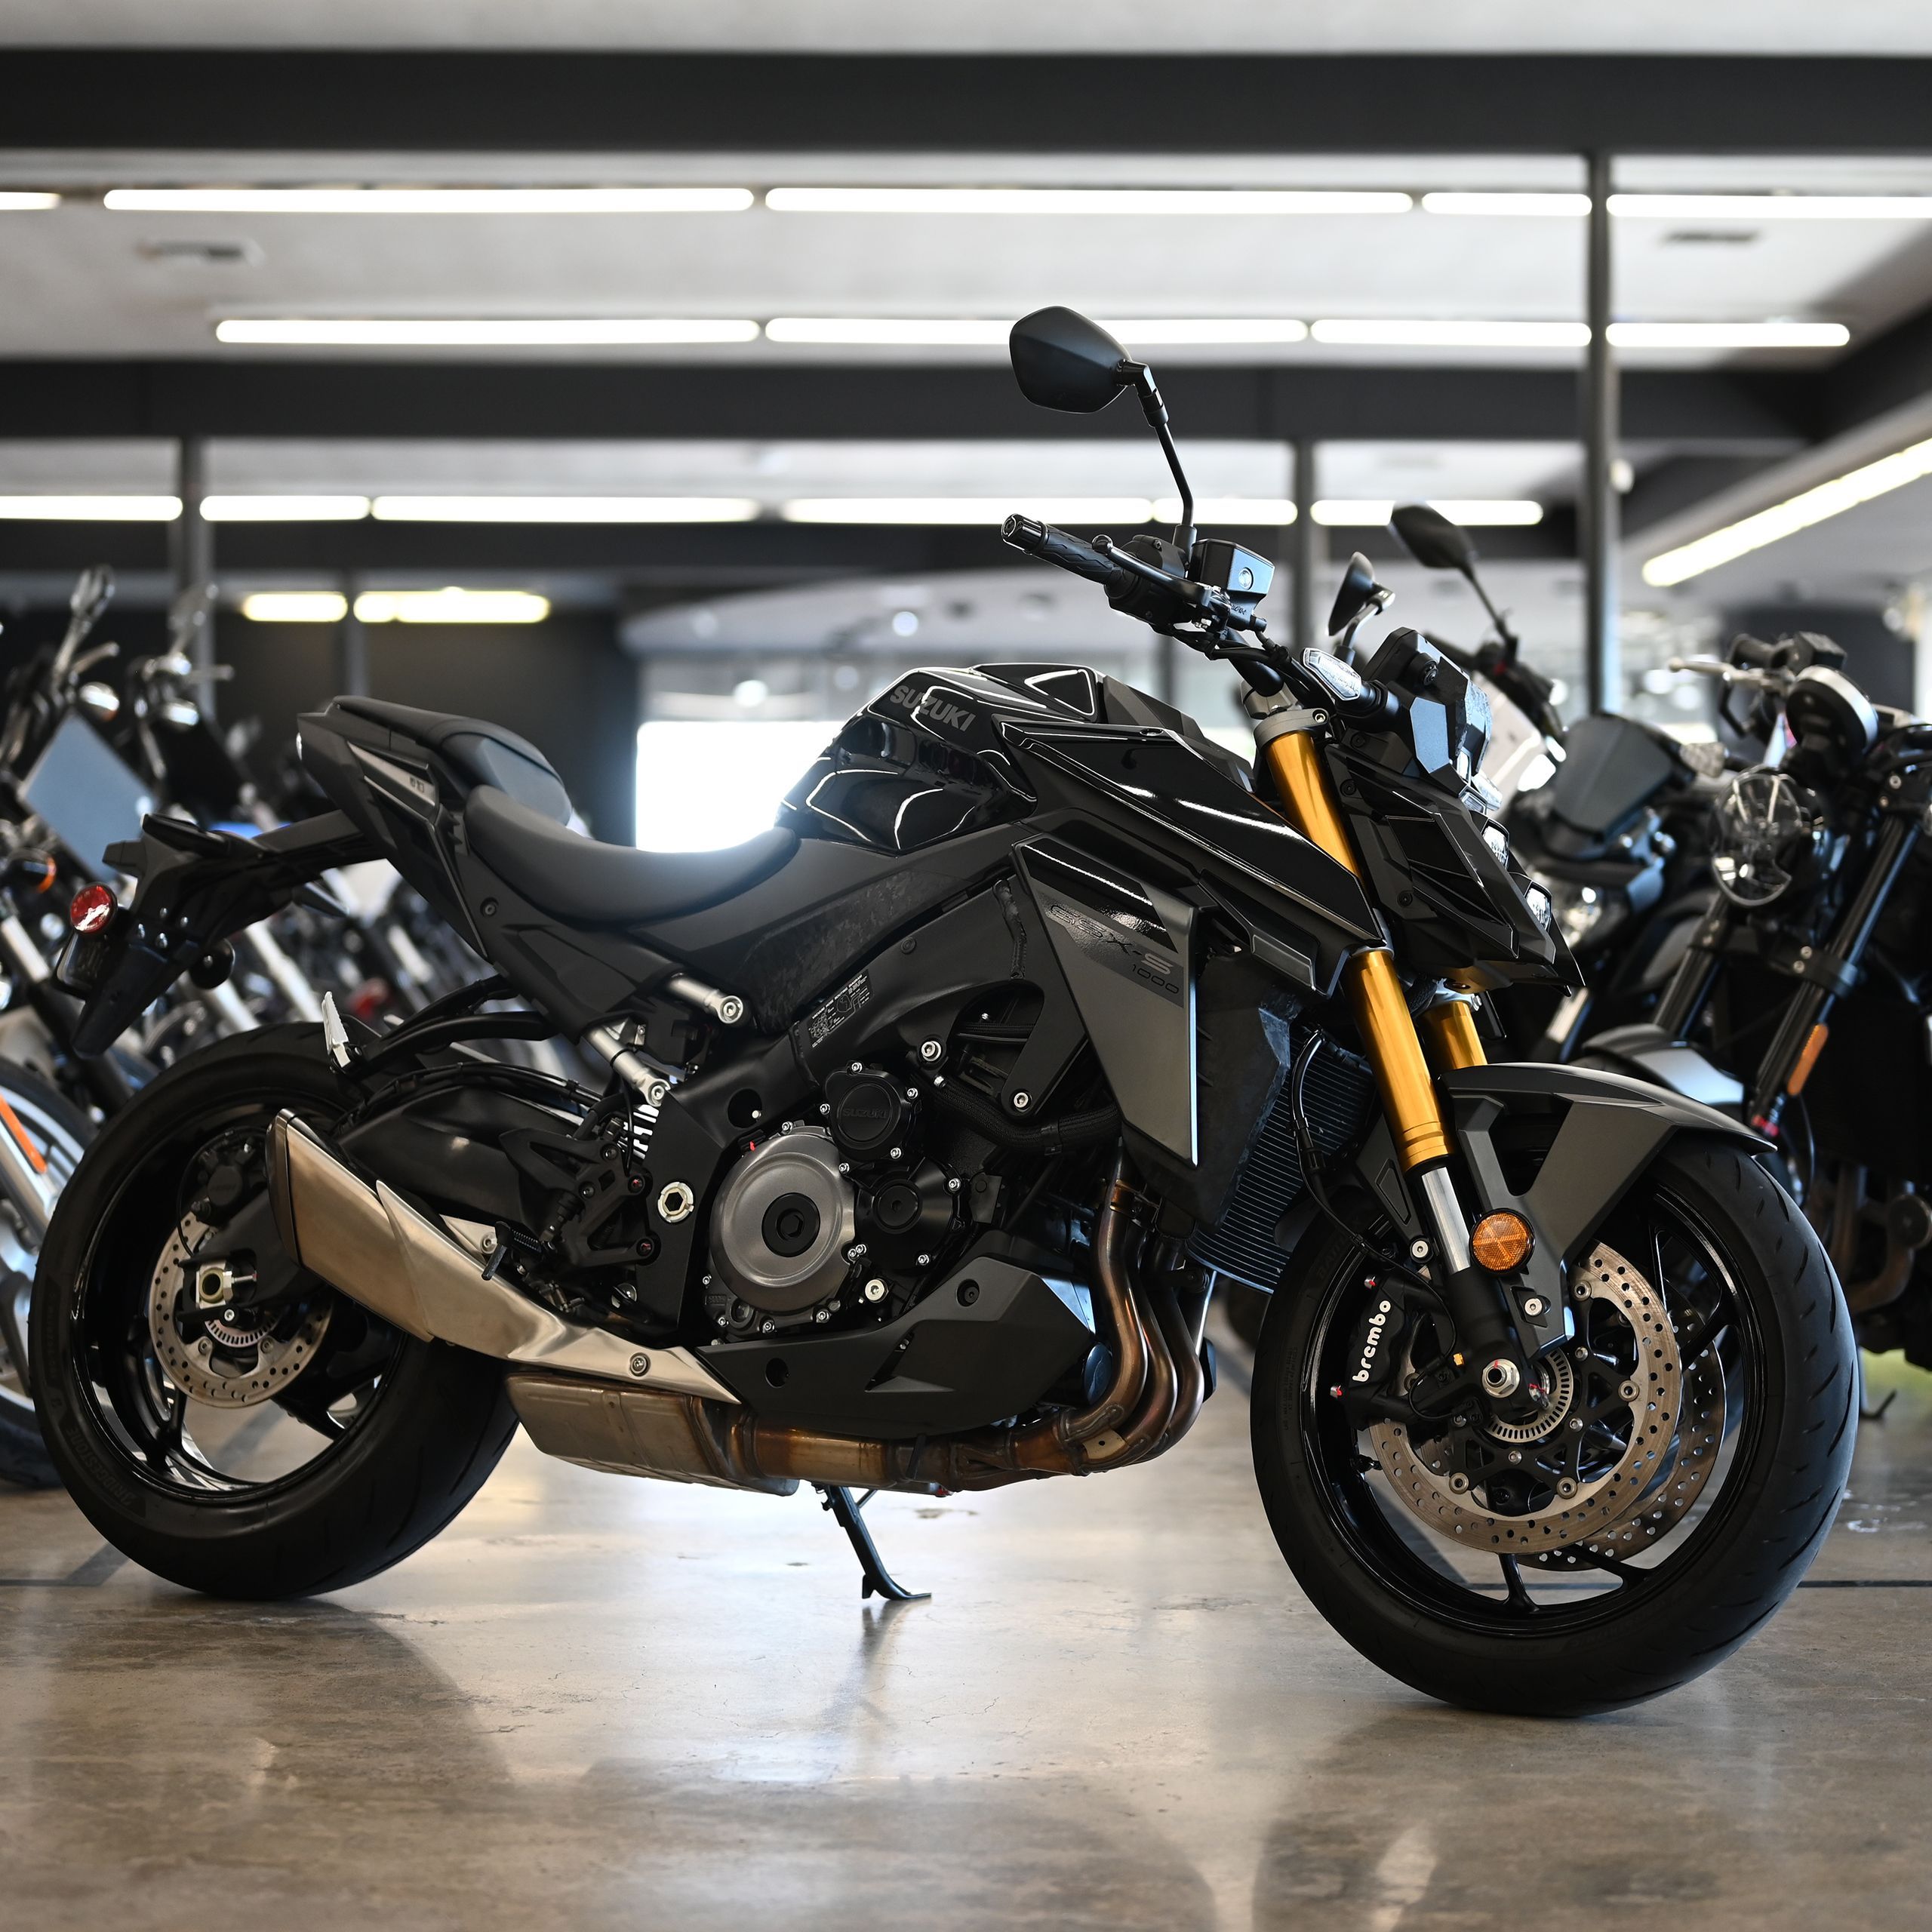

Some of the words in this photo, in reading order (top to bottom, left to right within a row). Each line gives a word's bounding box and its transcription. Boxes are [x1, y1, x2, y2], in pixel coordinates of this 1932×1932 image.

[890, 685, 976, 731] SUZUKI
[1131, 964, 1180, 994] 1000
[843, 1107, 889, 1118] SUZUKI
[1352, 1300, 1392, 1383] brembo
